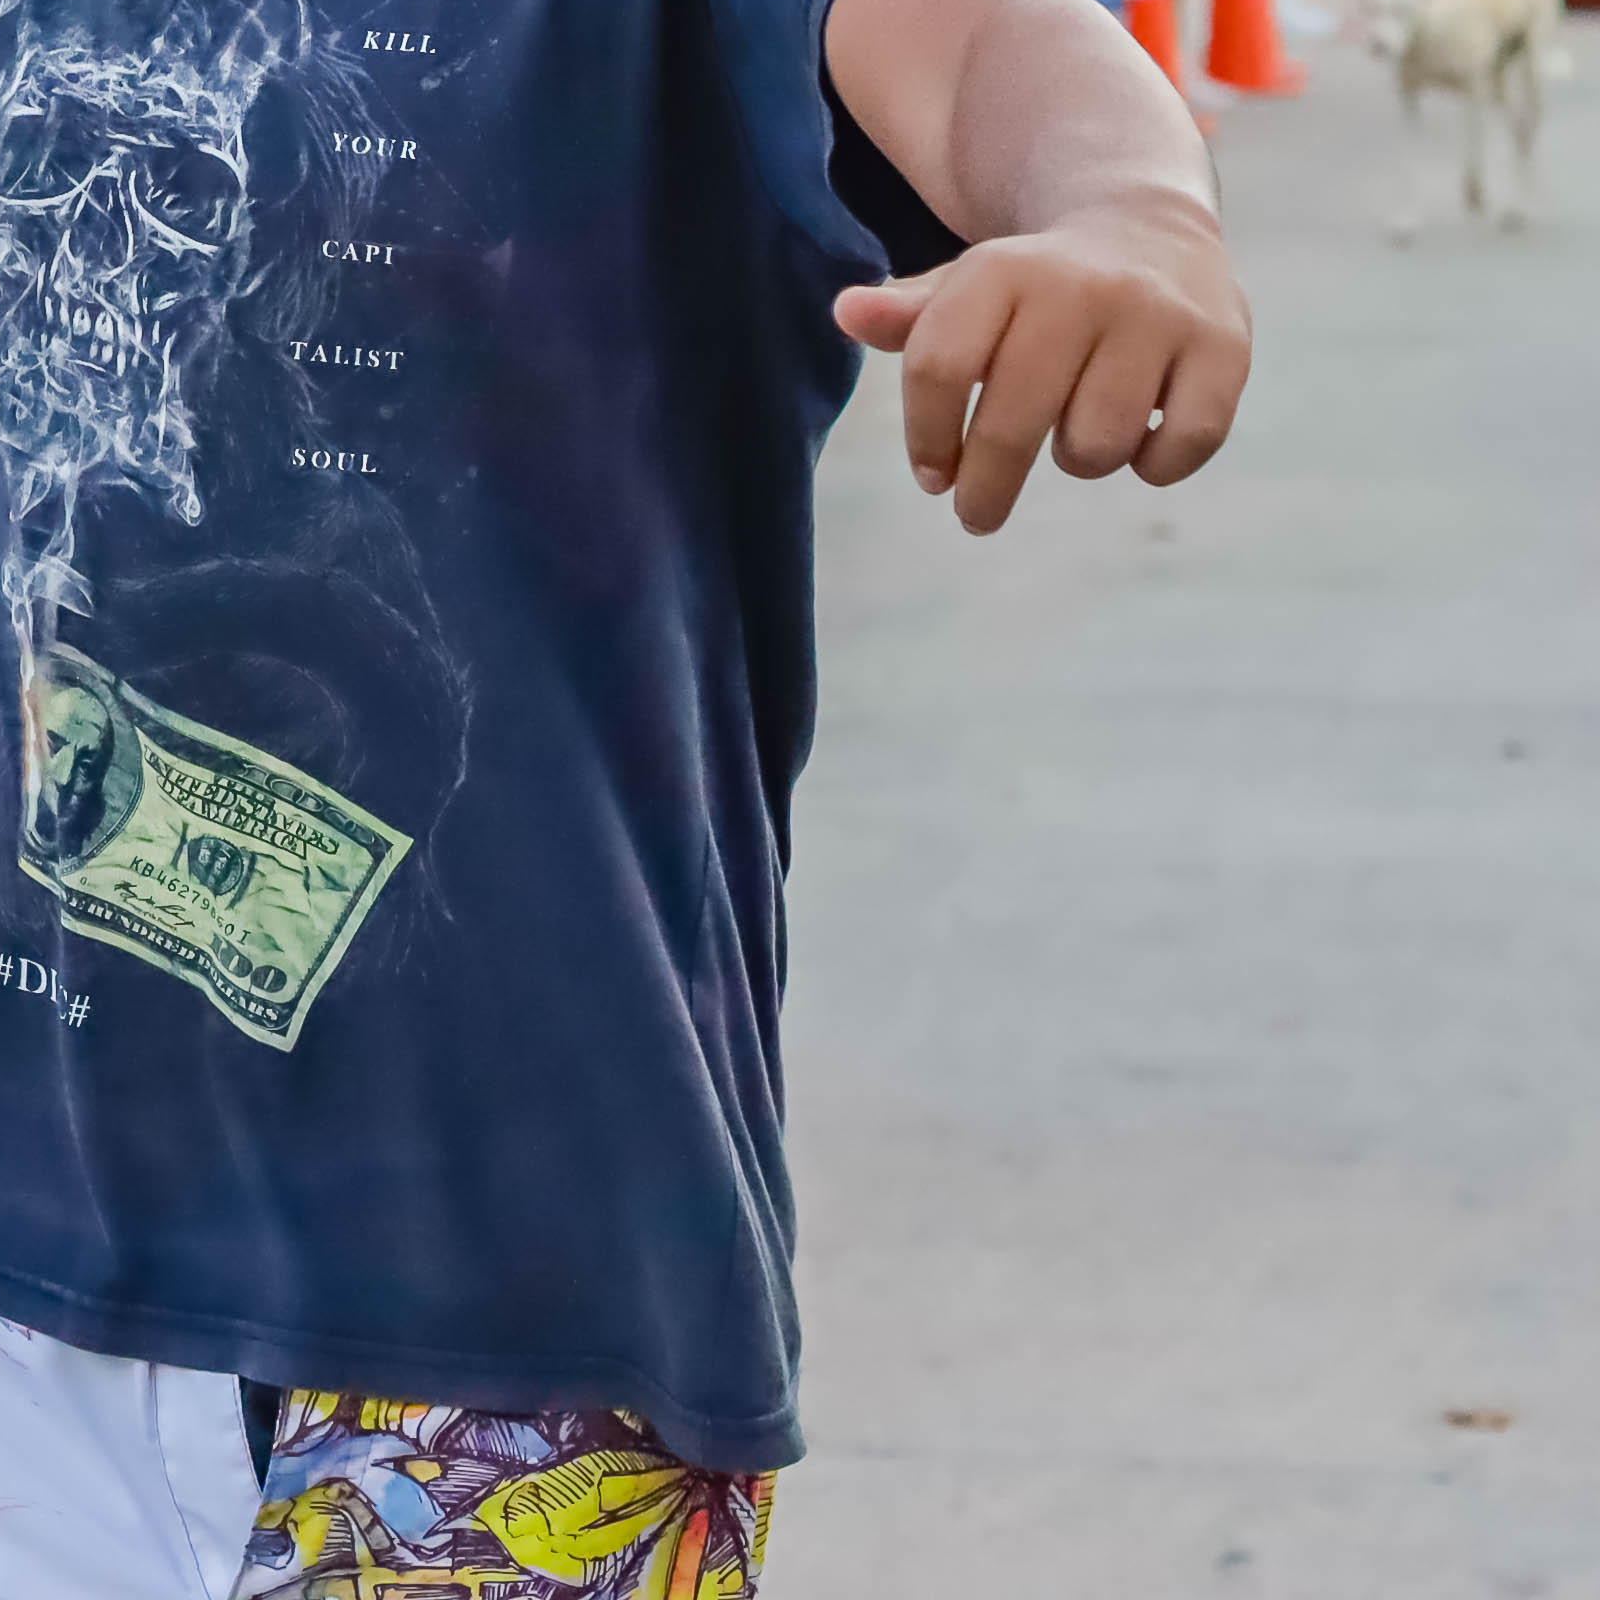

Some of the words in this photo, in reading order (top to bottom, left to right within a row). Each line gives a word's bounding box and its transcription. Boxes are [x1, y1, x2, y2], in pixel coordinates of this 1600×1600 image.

[362, 30, 436, 55] KILL
[333, 131, 418, 160] YOUR
[322, 239, 394, 265] CAPI
[289, 340, 405, 371] TALIST
[291, 447, 377, 474] SOUL
